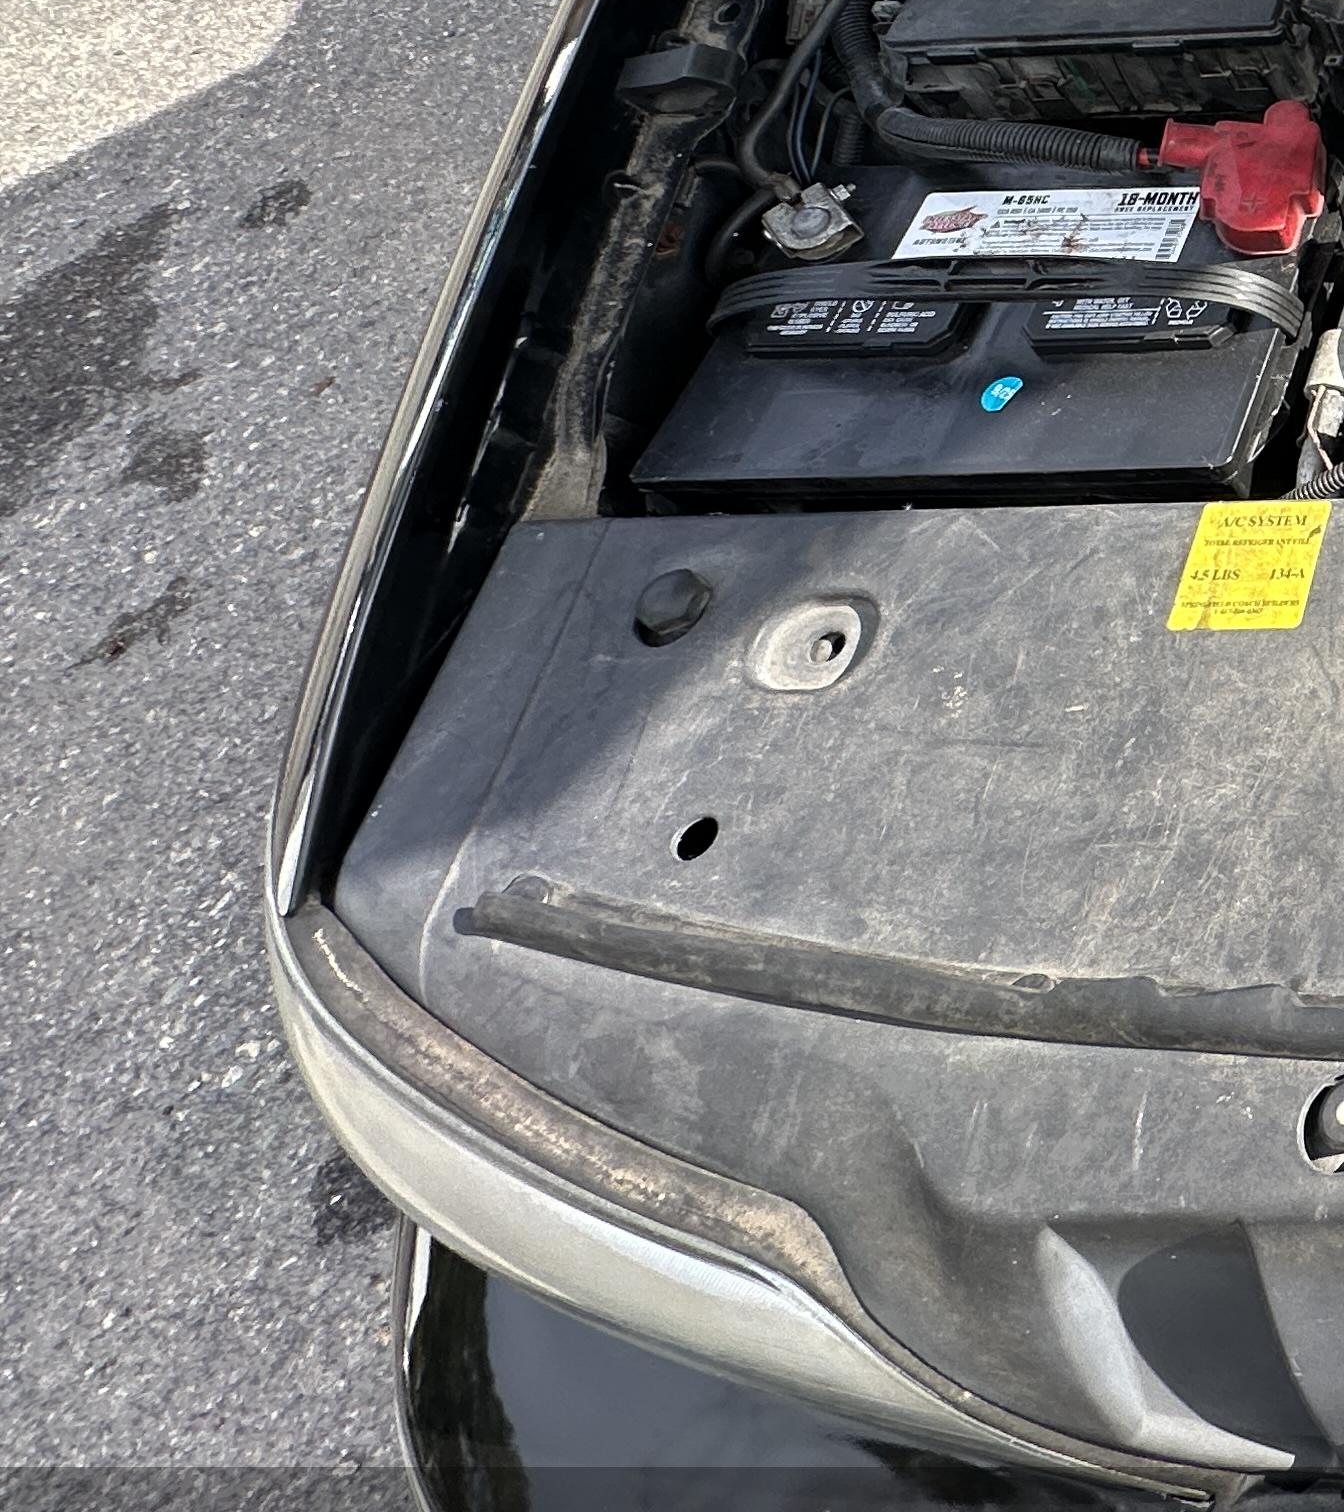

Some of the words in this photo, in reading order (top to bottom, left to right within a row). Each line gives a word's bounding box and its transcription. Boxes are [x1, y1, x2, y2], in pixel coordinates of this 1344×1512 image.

[1118, 191, 1200, 206] 18-MONTH
[1247, 514, 1308, 528] SYSTEM
[1212, 568, 1242, 581] LBS
